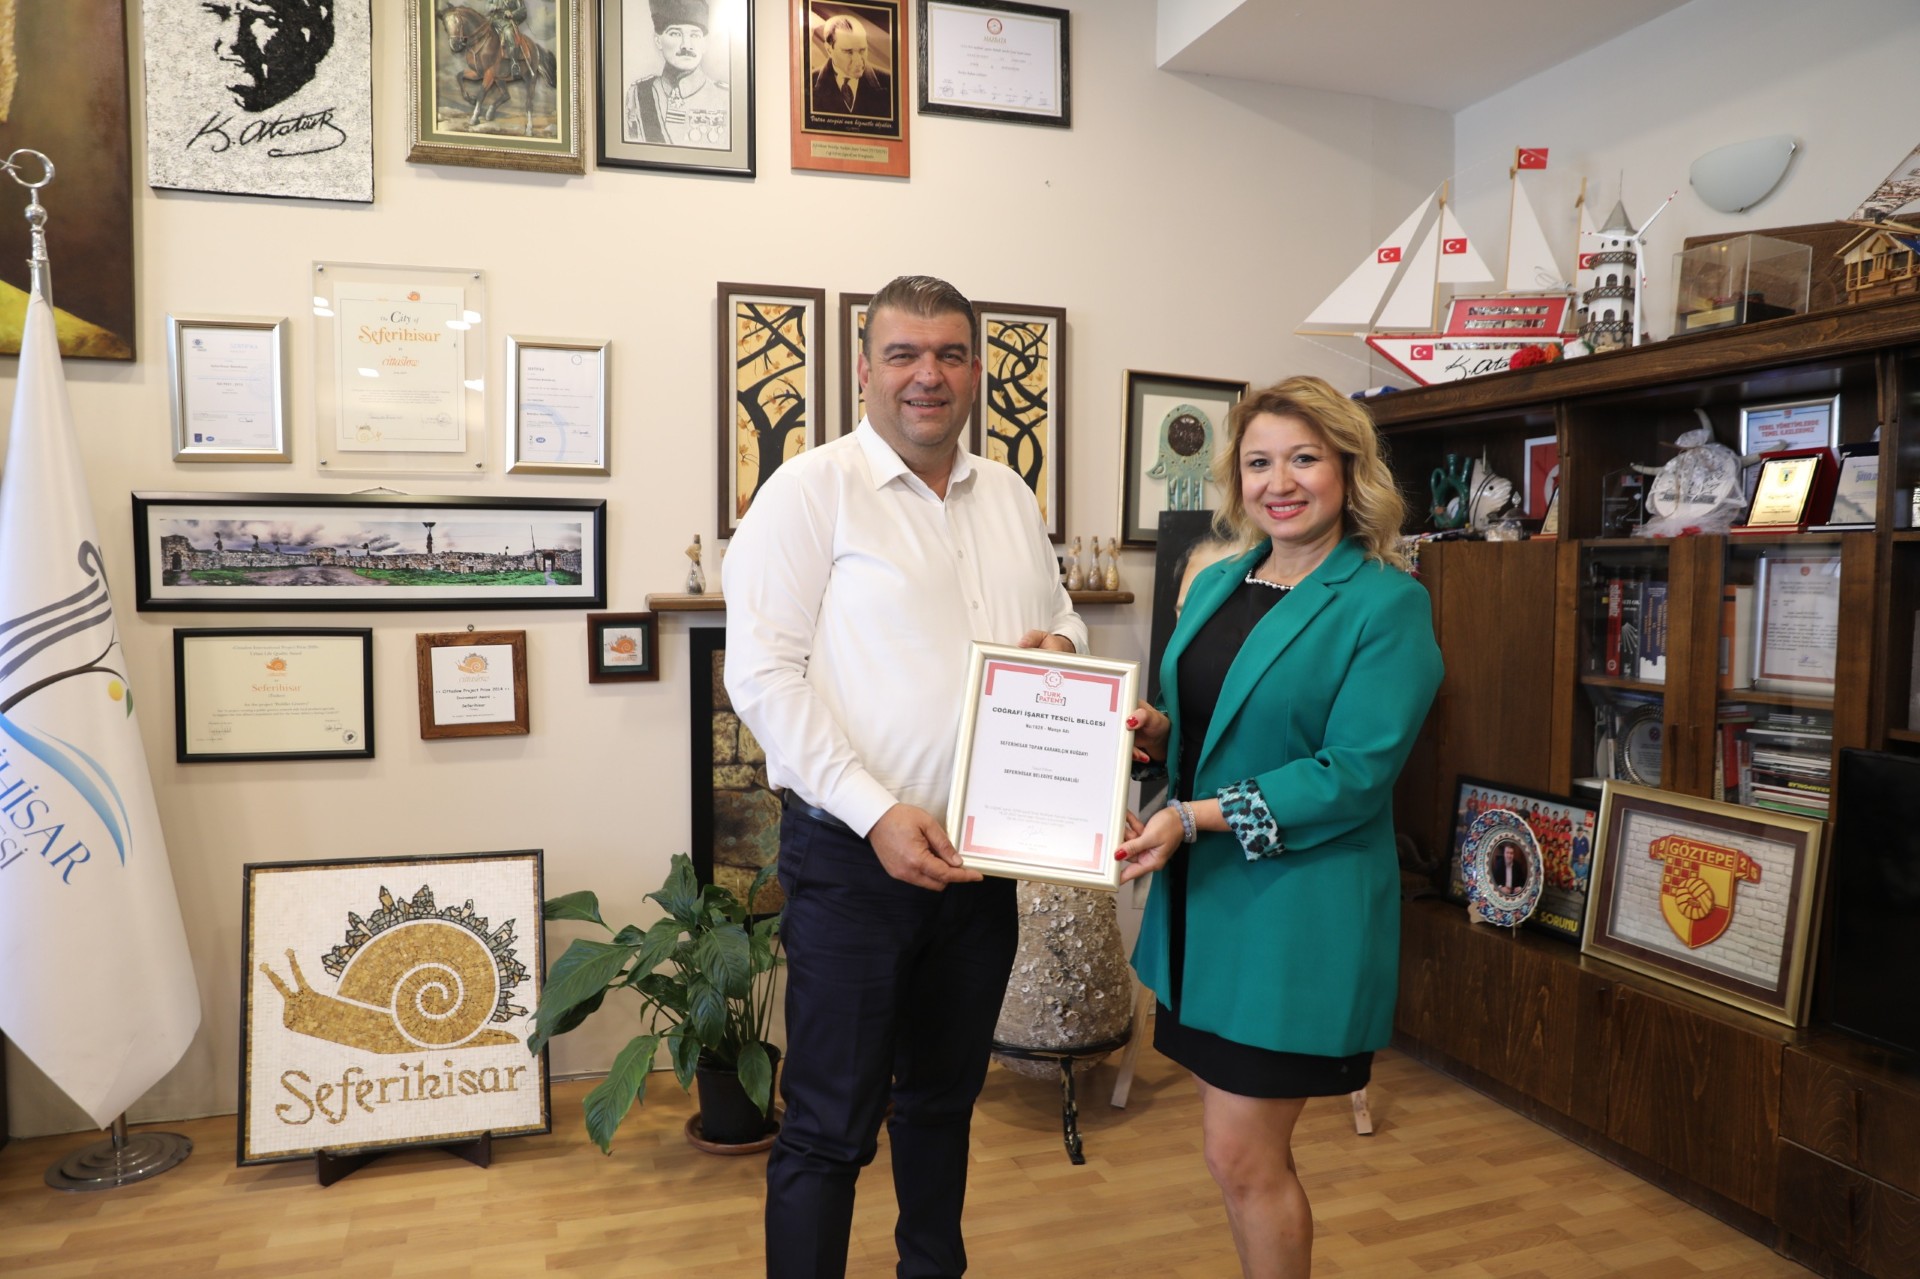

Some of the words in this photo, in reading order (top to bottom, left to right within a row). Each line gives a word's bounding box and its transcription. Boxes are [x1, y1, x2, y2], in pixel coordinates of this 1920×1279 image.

[390, 311, 411, 325] City
[358, 325, 441, 346] Seferihisar
[252, 684, 301, 692] Seferihisar
[1050, 715, 1075, 723] TESCİL
[1076, 718, 1106, 727] BELGESİ
[1668, 841, 1735, 868] GÖZTEPE
[274, 1058, 527, 1126] Seferihisar
